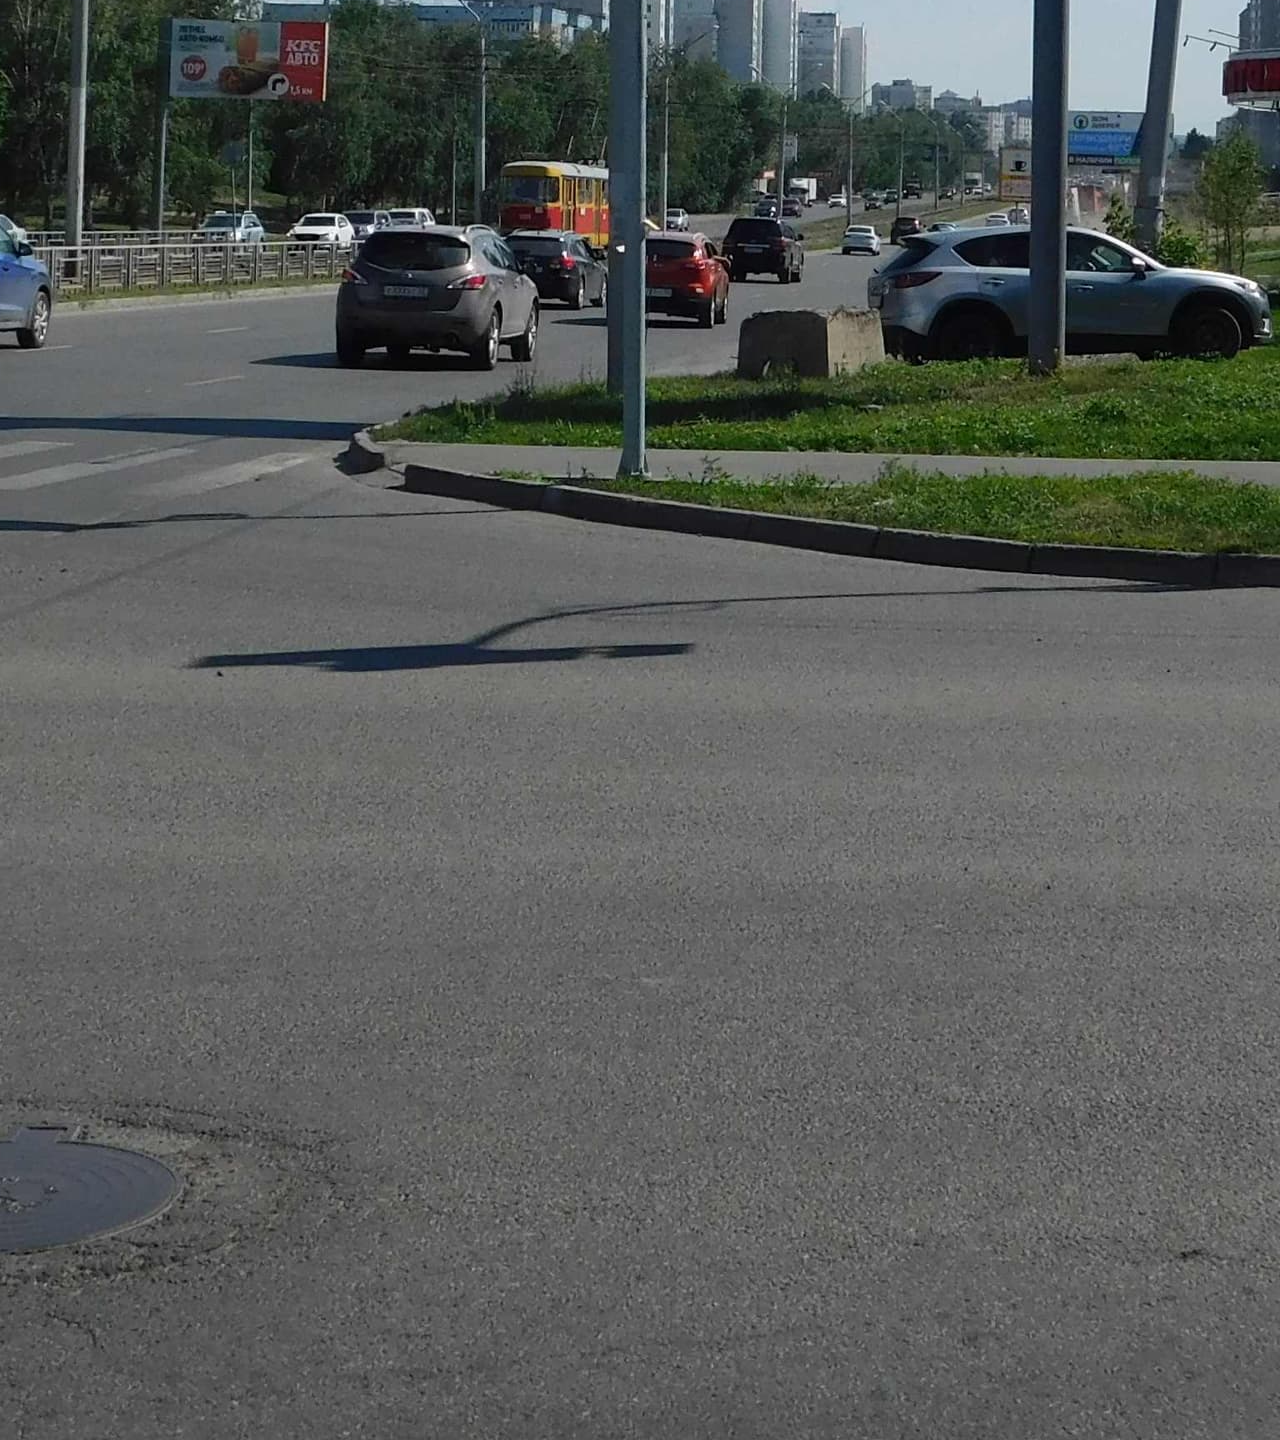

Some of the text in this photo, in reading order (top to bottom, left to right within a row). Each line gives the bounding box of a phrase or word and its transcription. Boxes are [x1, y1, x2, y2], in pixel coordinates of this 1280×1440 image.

[285, 40, 321, 52] KFC
[286, 52, 319, 66] АВТО
[290, 85, 301, 96] 1,5
